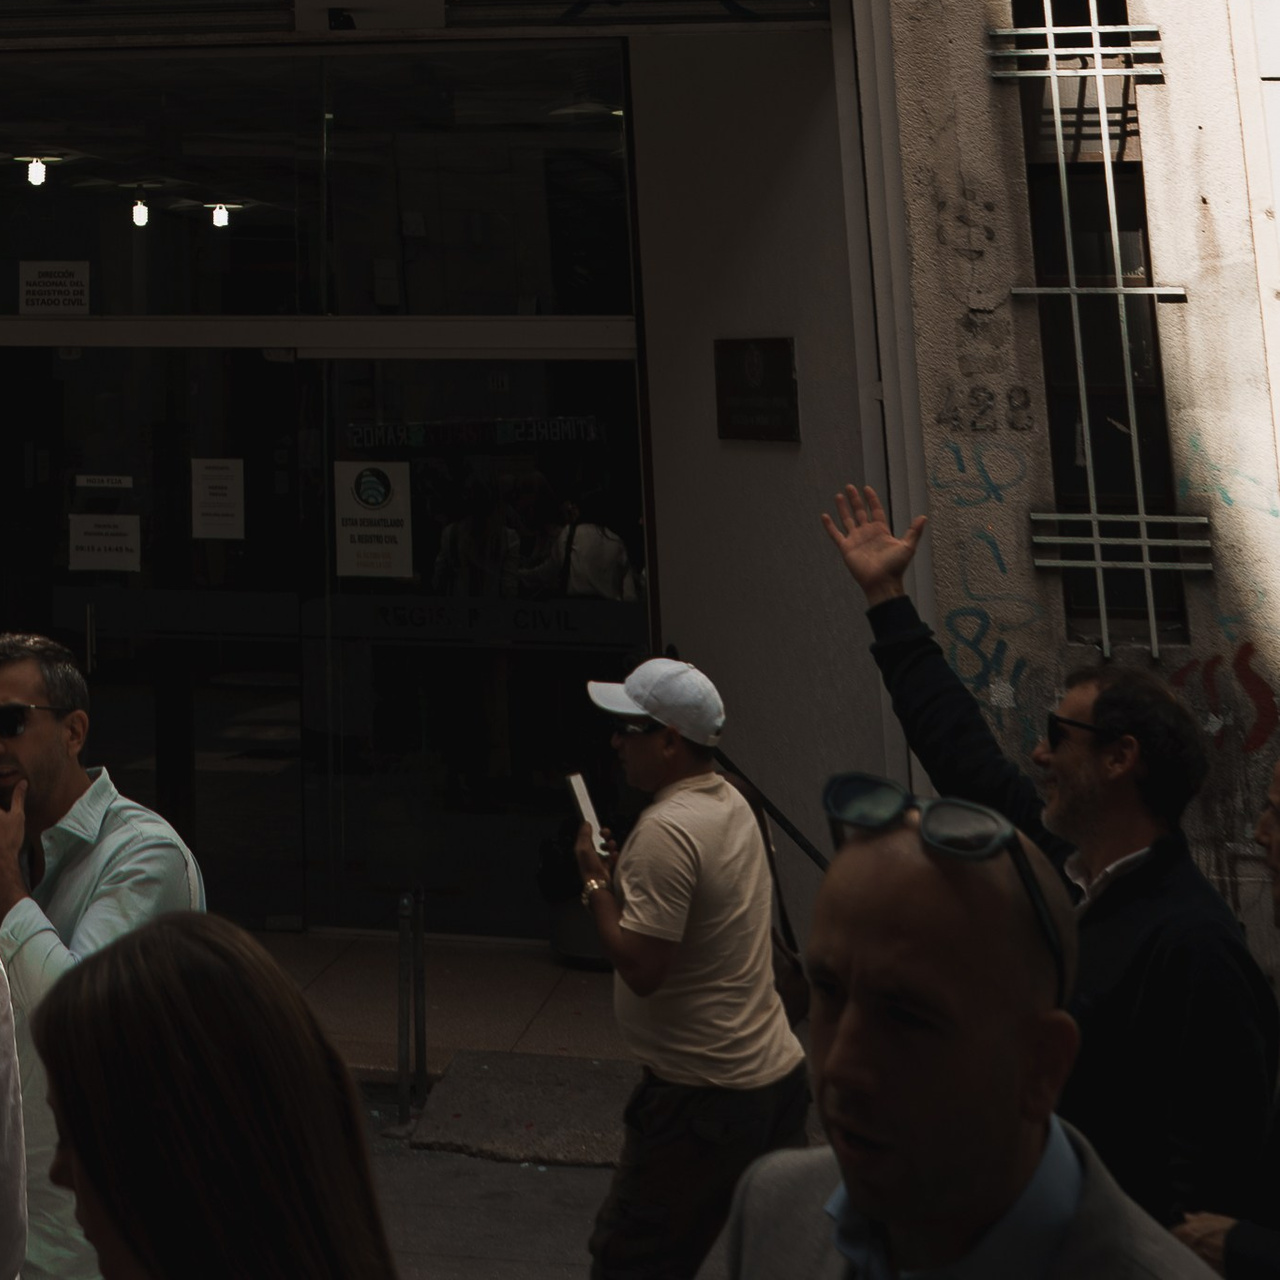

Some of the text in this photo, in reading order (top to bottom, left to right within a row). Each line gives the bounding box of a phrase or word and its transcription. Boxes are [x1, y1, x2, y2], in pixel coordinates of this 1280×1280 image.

[73, 289, 86, 297] DE
[25, 298, 61, 306] ESTADO
[513, 609, 578, 631] CIVIL
